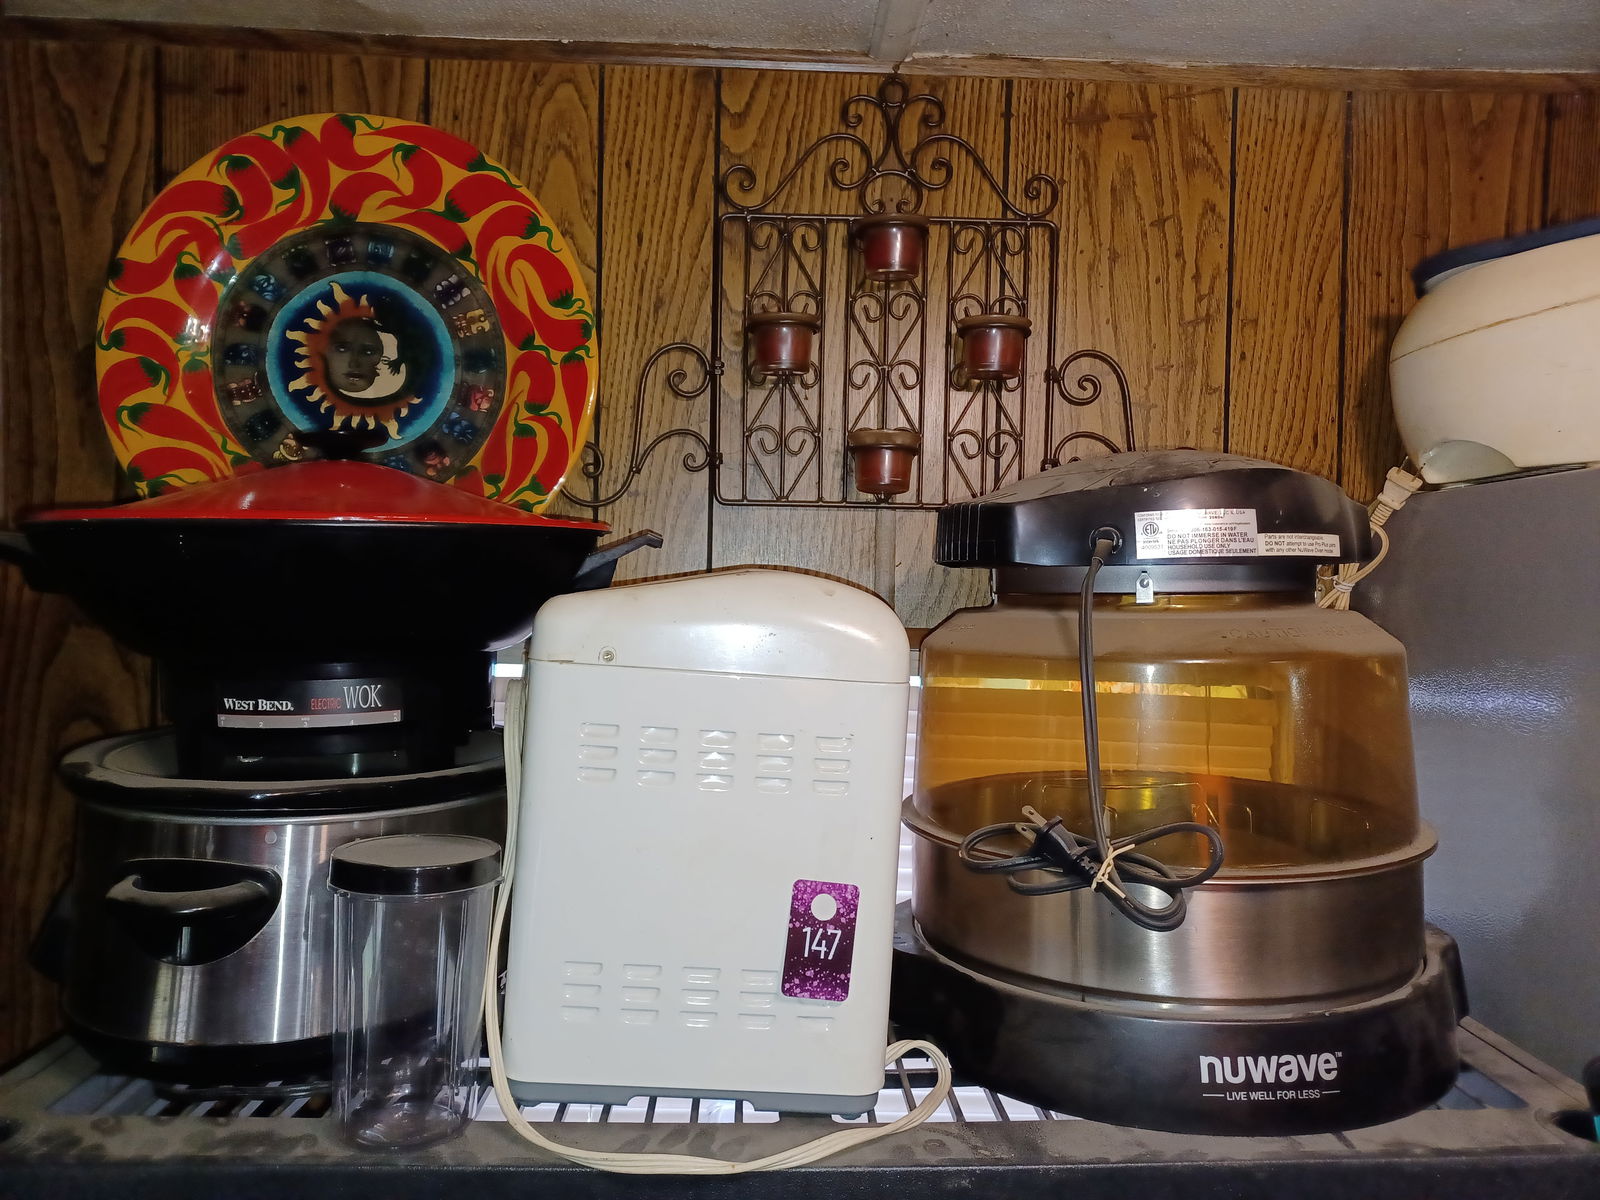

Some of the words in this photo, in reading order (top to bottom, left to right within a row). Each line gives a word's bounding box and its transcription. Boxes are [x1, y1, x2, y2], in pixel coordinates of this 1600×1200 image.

[224, 698, 255, 711] WEST
[310, 698, 341, 710] ELECTRIC
[343, 684, 382, 708] WOK
[802, 926, 842, 960] 147
[1226, 1091, 1247, 1100] LIVE
[1250, 1091, 1275, 1100] WELL
[1277, 1090, 1296, 1100] FOR
[1298, 1090, 1320, 1099] LESS
